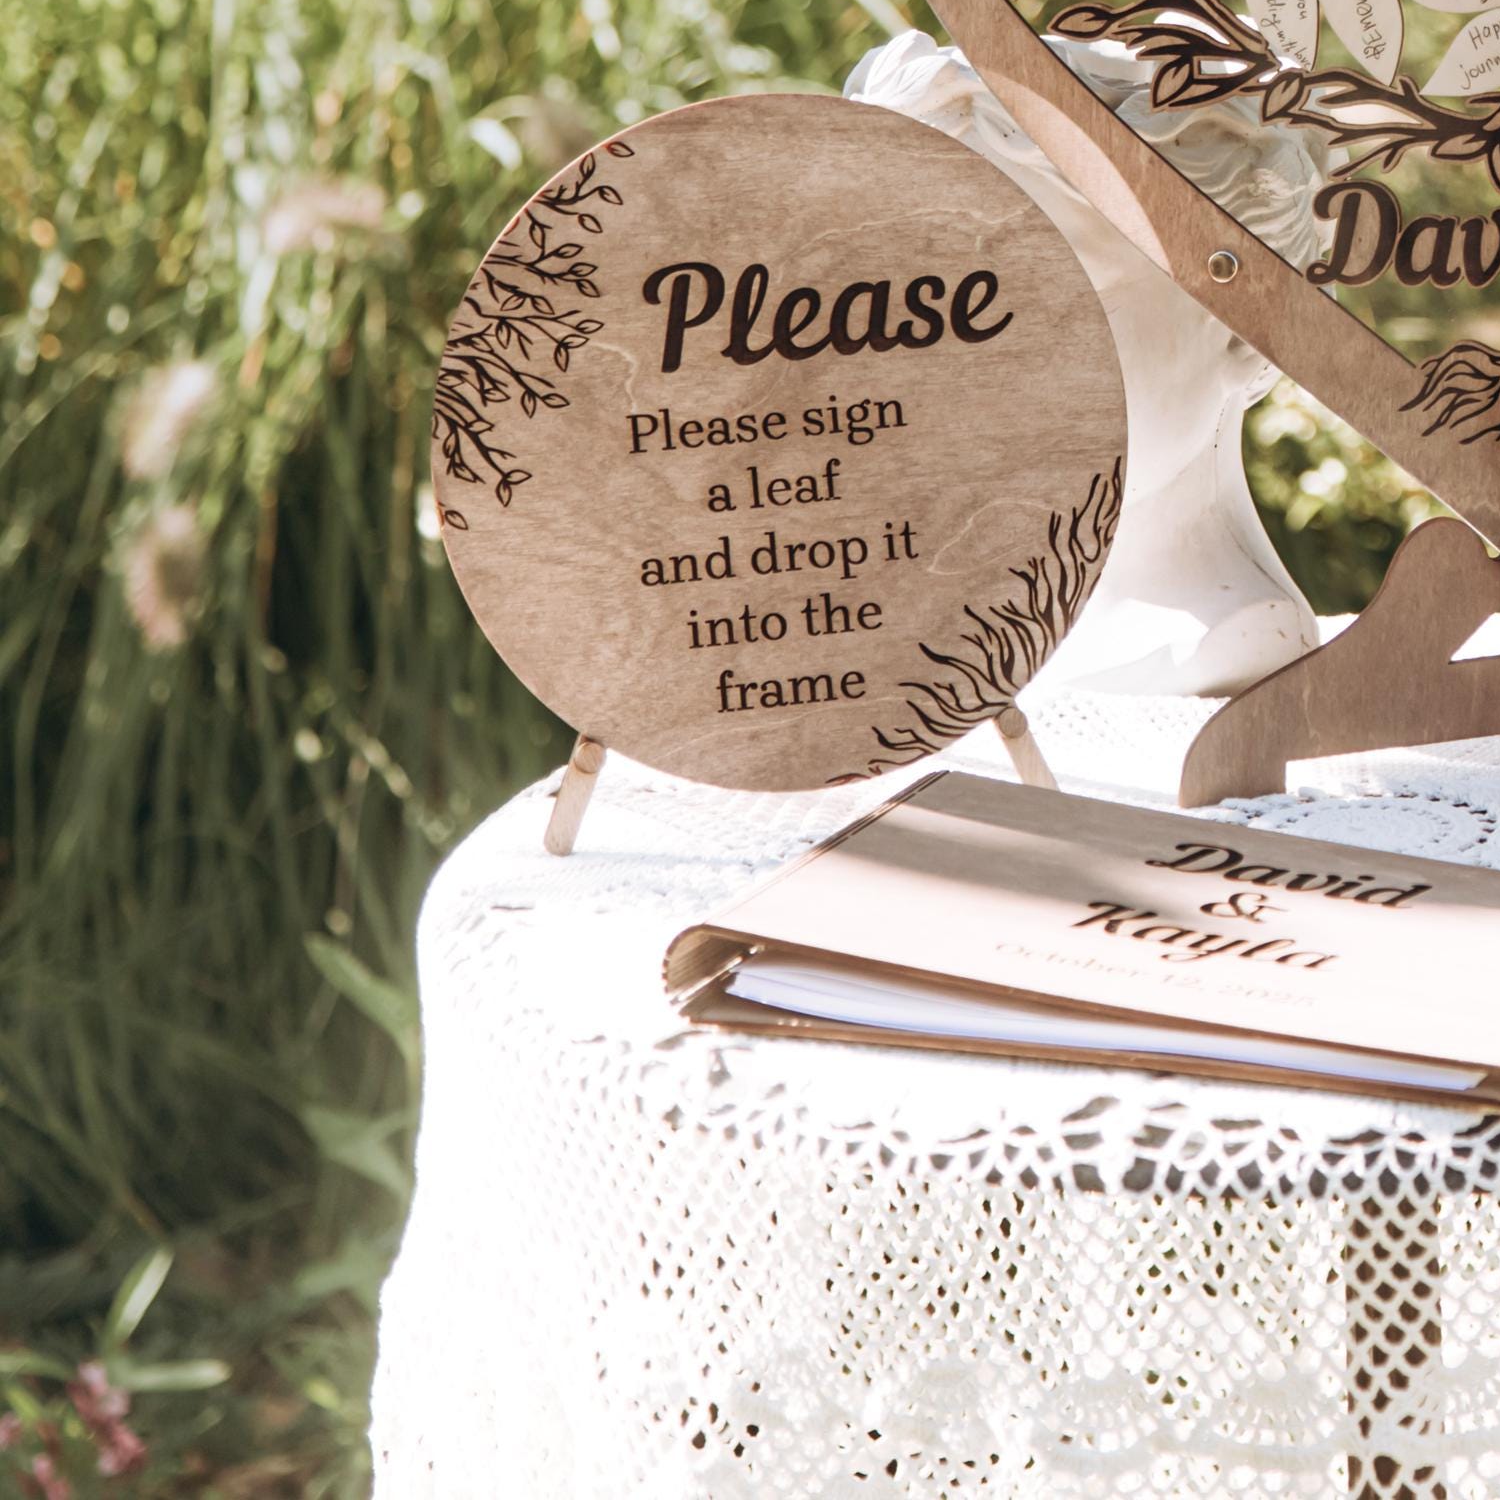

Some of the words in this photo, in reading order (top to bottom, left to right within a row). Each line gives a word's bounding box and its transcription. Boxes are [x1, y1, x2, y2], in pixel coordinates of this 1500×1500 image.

[642, 262, 1014, 373] Please
[625, 408, 788, 454] Please
[802, 395, 908, 446] sign
[707, 482, 737, 512] a
[746, 457, 842, 509] leaf
[640, 536, 738, 587] and
[751, 531, 868, 580] drop
[882, 521, 919, 562] it
[687, 605, 788, 649] into
[800, 592, 883, 637] the
[716, 669, 866, 713] frame
[1144, 842, 1433, 909] David
[1070, 900, 1341, 970] Kayla
[1199, 892, 1288, 923] &
